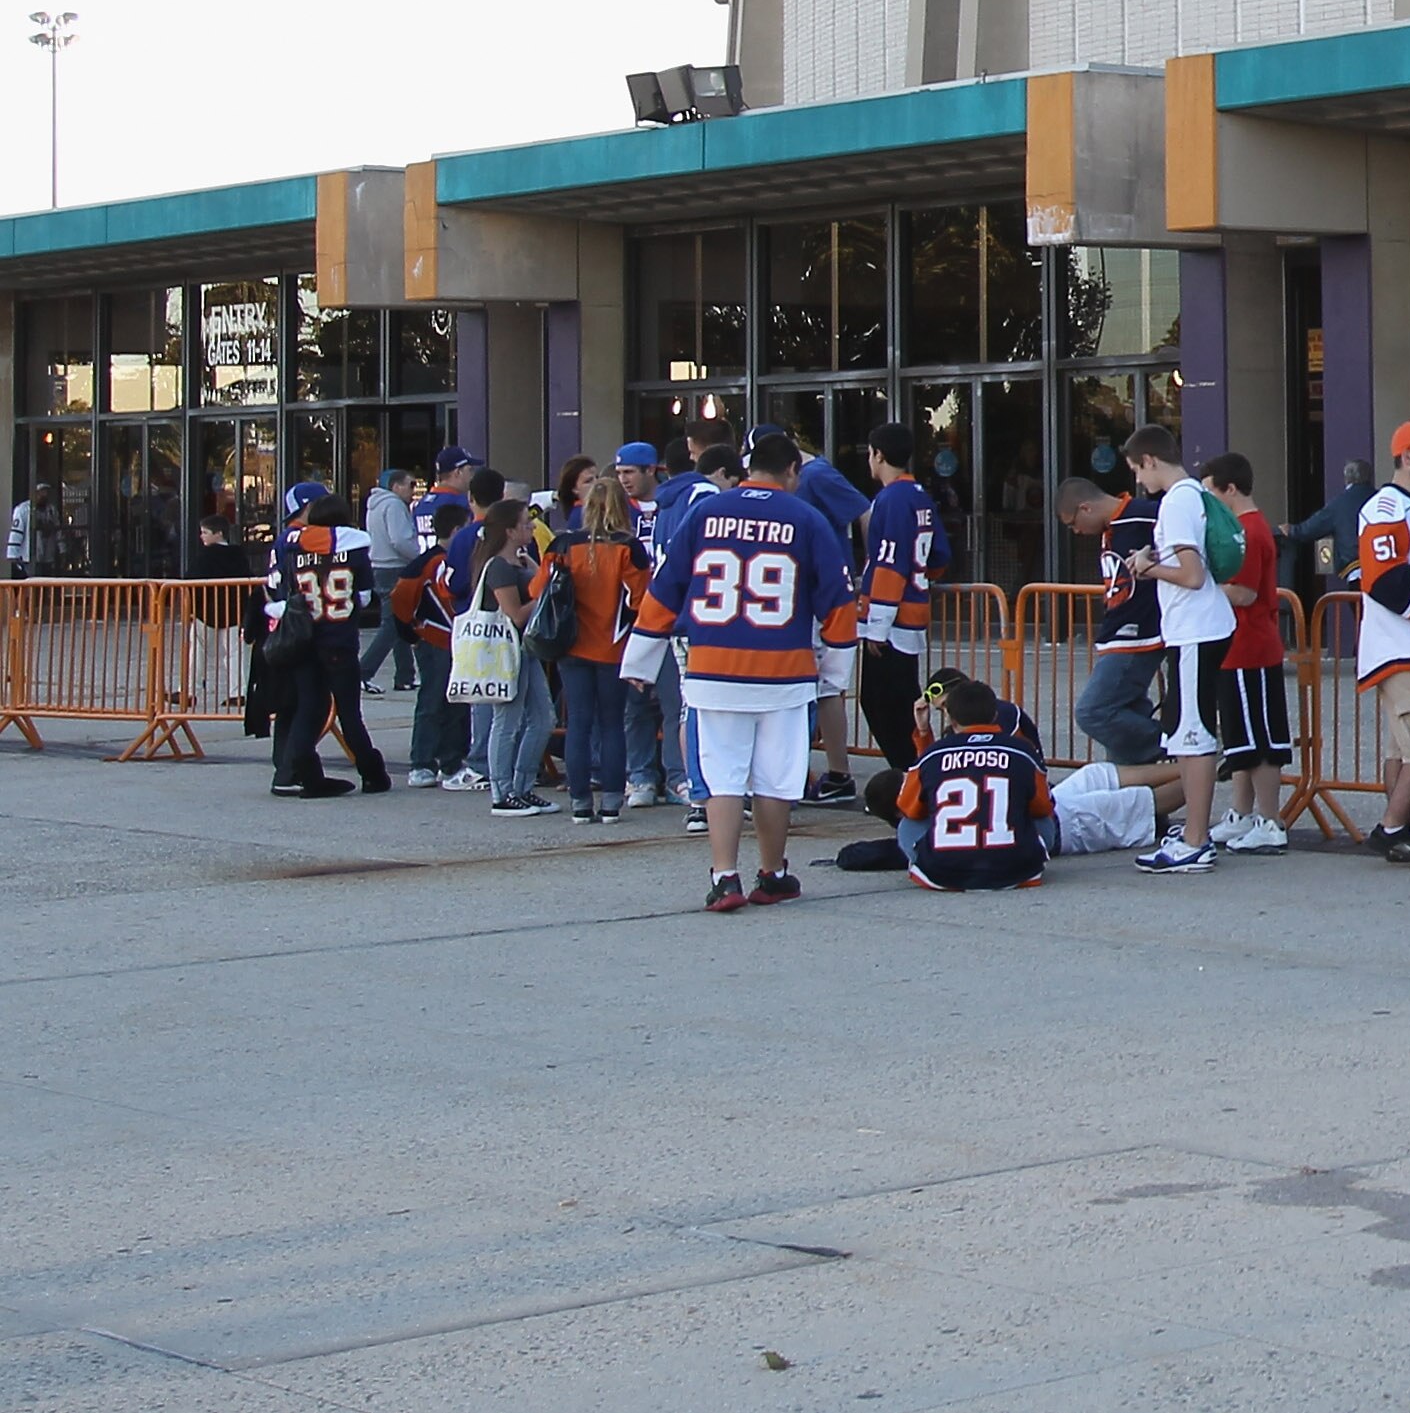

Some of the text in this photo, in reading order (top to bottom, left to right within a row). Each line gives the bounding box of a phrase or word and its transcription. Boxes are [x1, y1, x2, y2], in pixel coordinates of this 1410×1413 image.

[208, 339, 241, 366] GATES
[704, 517, 795, 545] DIPIETRO
[1372, 534, 1397, 562] 51
[295, 568, 354, 621] 39
[691, 548, 799, 629] 39
[458, 621, 513, 644] AGUNA
[449, 680, 509, 698] BEACH
[941, 751, 1010, 772] OKPOSO
[933, 776, 1016, 850] 21
